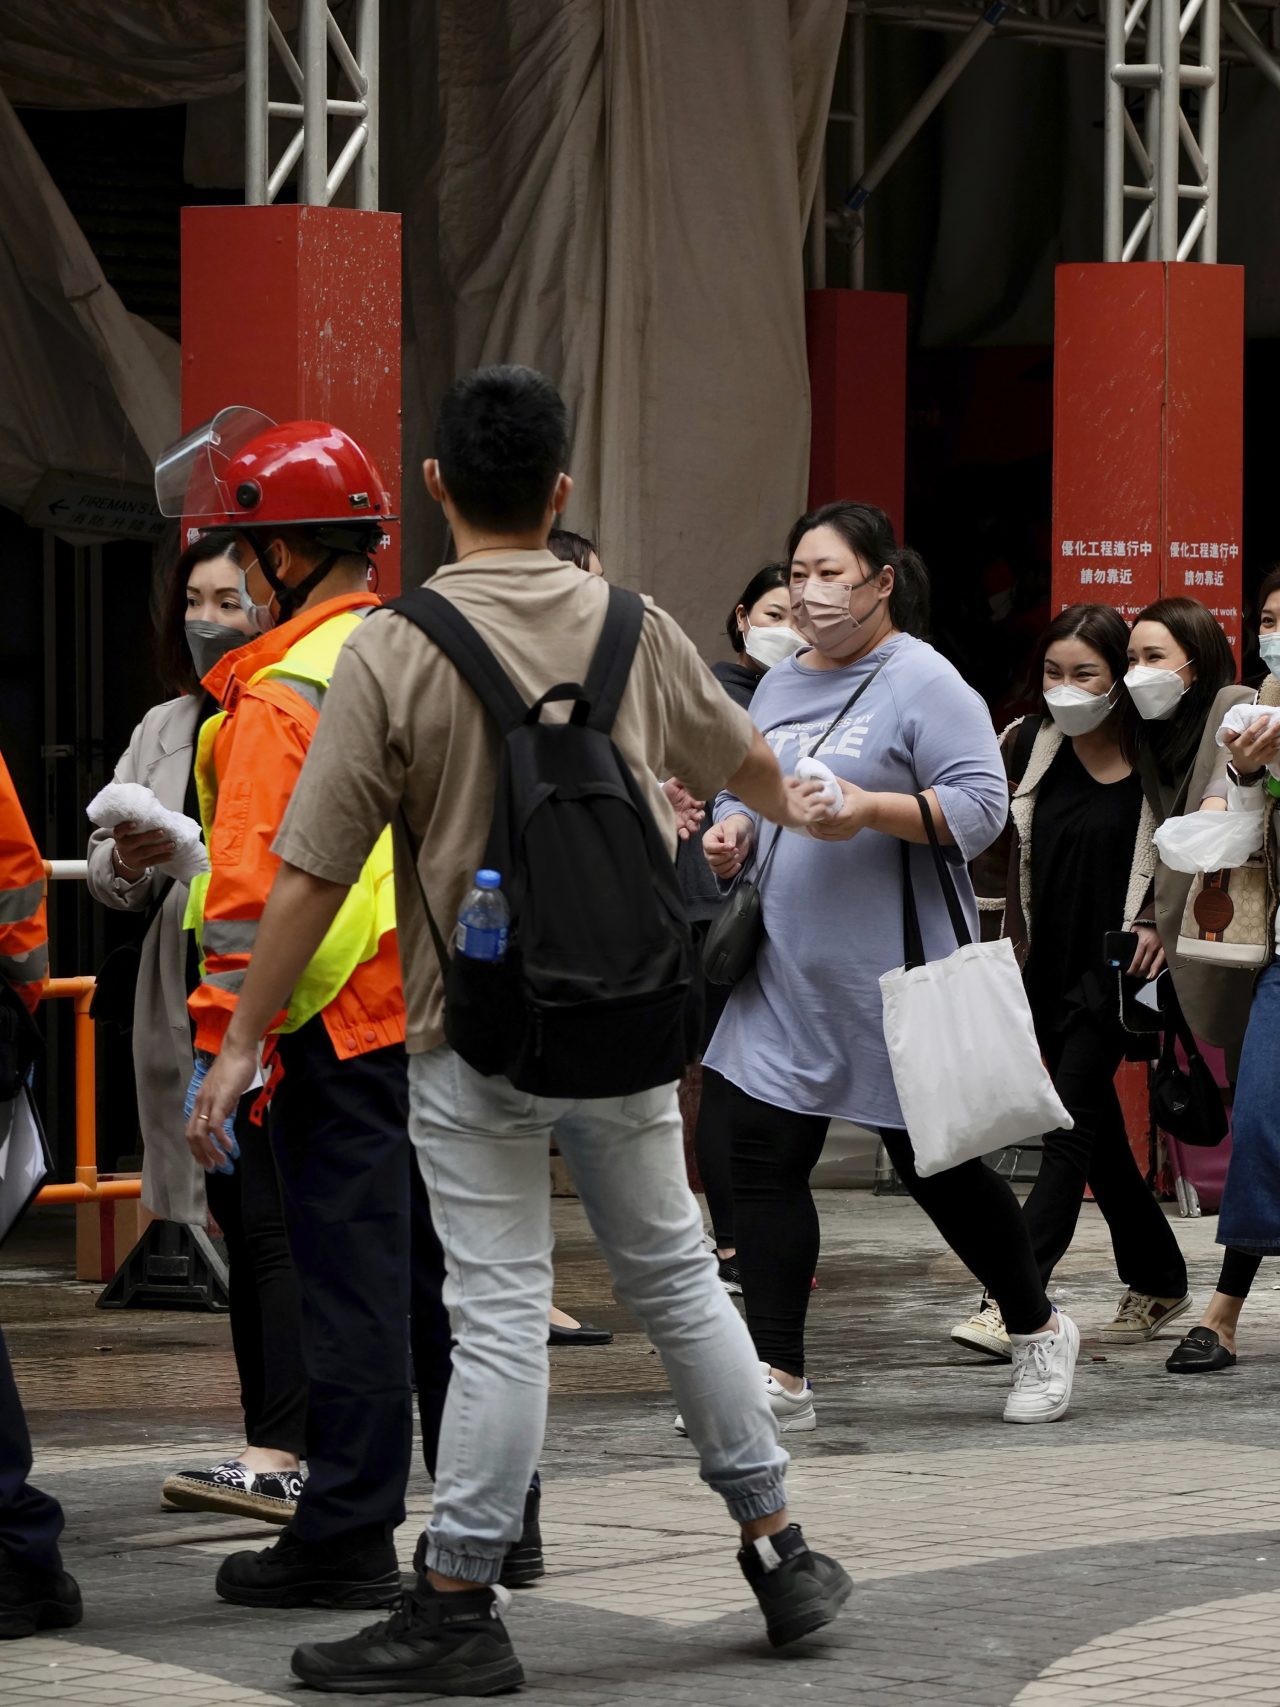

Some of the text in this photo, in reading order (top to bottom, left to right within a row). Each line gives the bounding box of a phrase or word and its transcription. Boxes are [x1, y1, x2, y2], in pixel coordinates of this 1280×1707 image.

[1061, 540, 1153, 557] 優化工程進行中
[1170, 542, 1239, 559] 優化工程進行中
[1080, 568, 1133, 585] 請勿靠近
[1184, 570, 1225, 586] 請勿靠近
